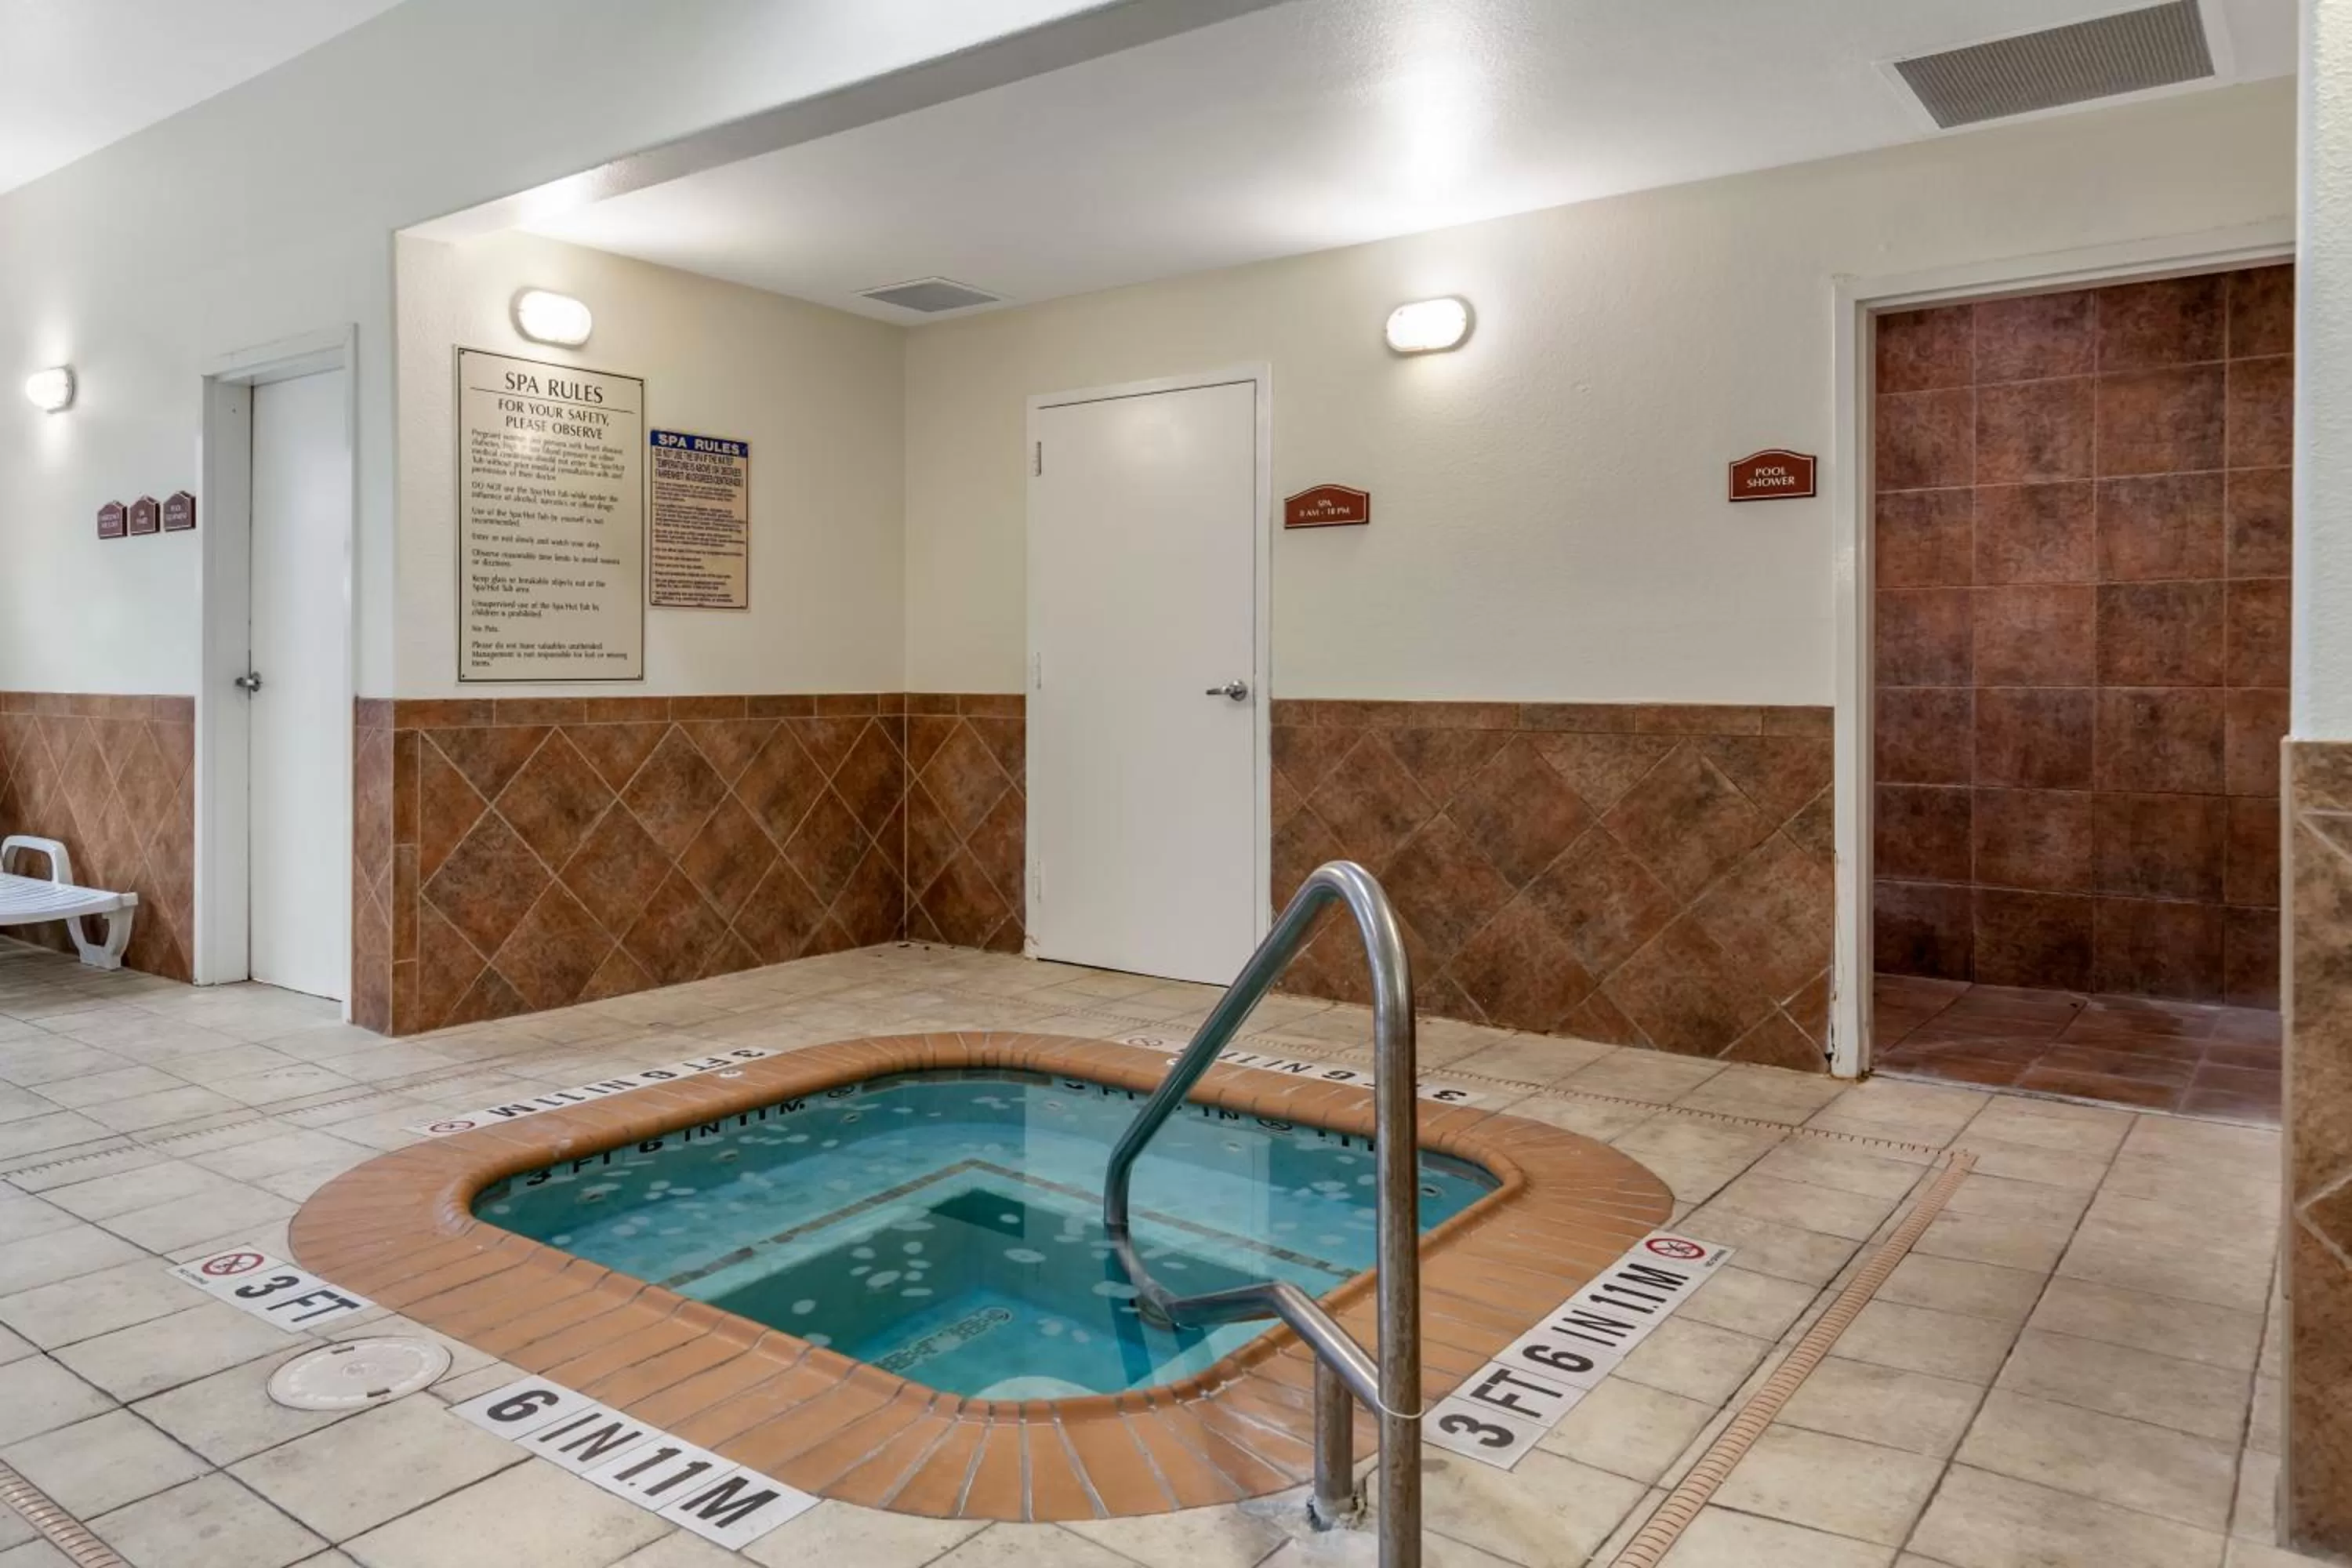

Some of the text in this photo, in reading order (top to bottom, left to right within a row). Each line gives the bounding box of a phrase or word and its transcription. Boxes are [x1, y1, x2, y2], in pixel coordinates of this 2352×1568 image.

[505, 372, 603, 404] SPA RULES
[499, 398, 610, 427] FOR YOUR SAFETY,
[506, 416, 603, 440] PLEASE OBSERVE
[659, 433, 740, 455] SPA RULES
[1747, 476, 1795, 488] SHOWER
[1755, 466, 1787, 477] POOL
[235, 1275, 300, 1299] 3
[266, 1289, 361, 1323] FT
[1552, 1309, 1636, 1348] IN
[1522, 1345, 1595, 1373] 6
[1468, 1368, 1564, 1418] FT
[486, 1389, 559, 1423] 6
[539, 1413, 643, 1462] IN
[1439, 1413, 1515, 1448] 3
